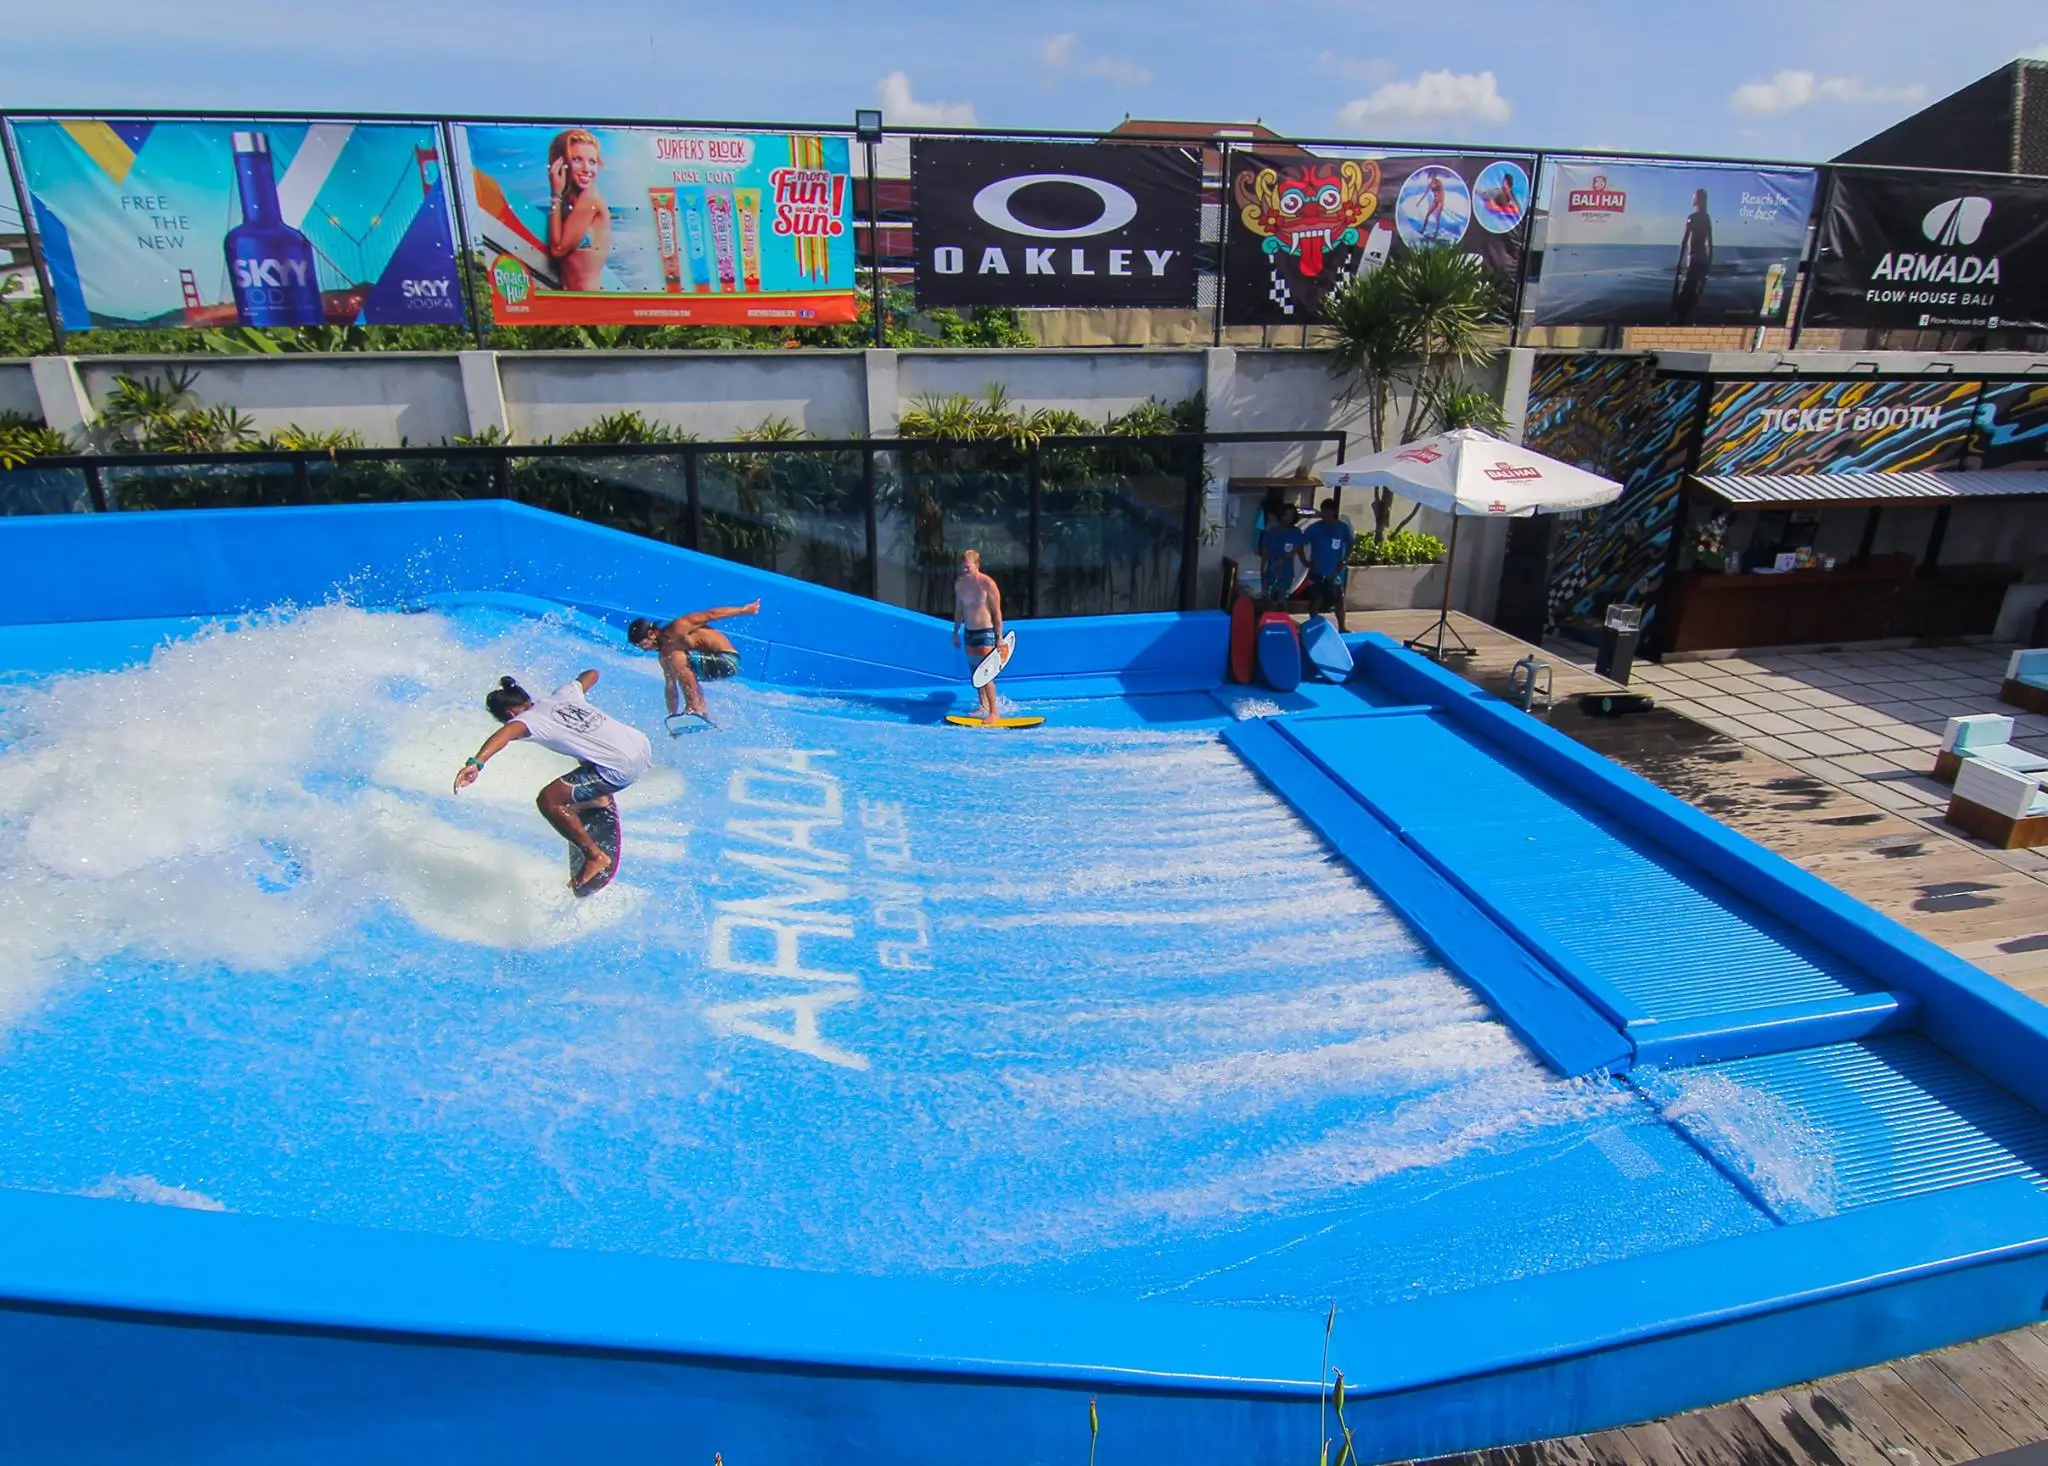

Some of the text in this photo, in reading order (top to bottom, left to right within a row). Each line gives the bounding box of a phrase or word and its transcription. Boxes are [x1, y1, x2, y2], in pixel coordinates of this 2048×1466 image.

[656, 138, 748, 163] SURFERS BLOCK
[797, 170, 830, 182] more
[770, 169, 829, 205] Fun
[121, 195, 169, 211] FREE
[1572, 193, 1624, 207] BALI HAI
[1740, 191, 1774, 205] Reach
[150, 215, 190, 230] THE
[1739, 206, 1778, 220] the best
[138, 235, 185, 250] NEW
[933, 246, 1175, 276] OAKLEY
[1871, 253, 2000, 284] ARMADA
[235, 258, 308, 288] SKYY
[493, 268, 530, 287] Beach
[402, 279, 450, 298] SKYY
[505, 281, 527, 305] Hut
[1866, 289, 1996, 306] FLOW HOUSE BALI
[1760, 406, 1943, 432] TICKET BOOTH
[701, 747, 869, 1071] ARMADA
